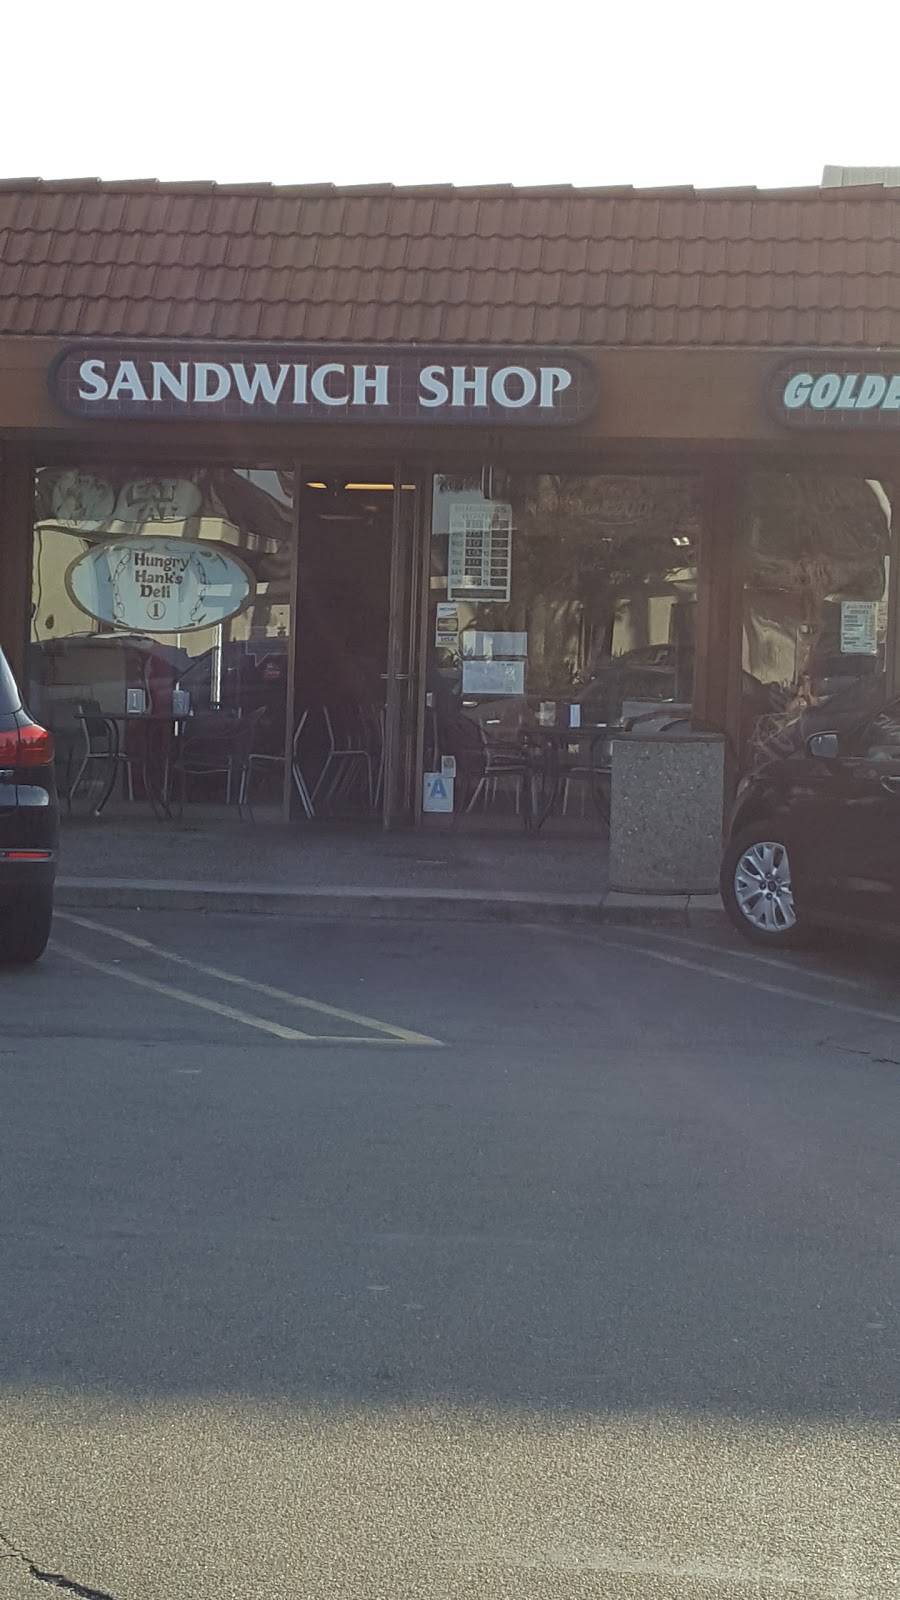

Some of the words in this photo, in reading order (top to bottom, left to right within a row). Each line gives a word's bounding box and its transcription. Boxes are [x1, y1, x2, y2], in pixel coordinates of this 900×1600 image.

[77, 358, 390, 407] SANDWICH
[417, 364, 573, 410] SHOP
[784, 373, 900, 409] GOLDE
[134, 551, 191, 572] Hungry
[135, 570, 184, 585] Hank's
[140, 584, 171, 599] Deli
[430, 778, 448, 800] A
